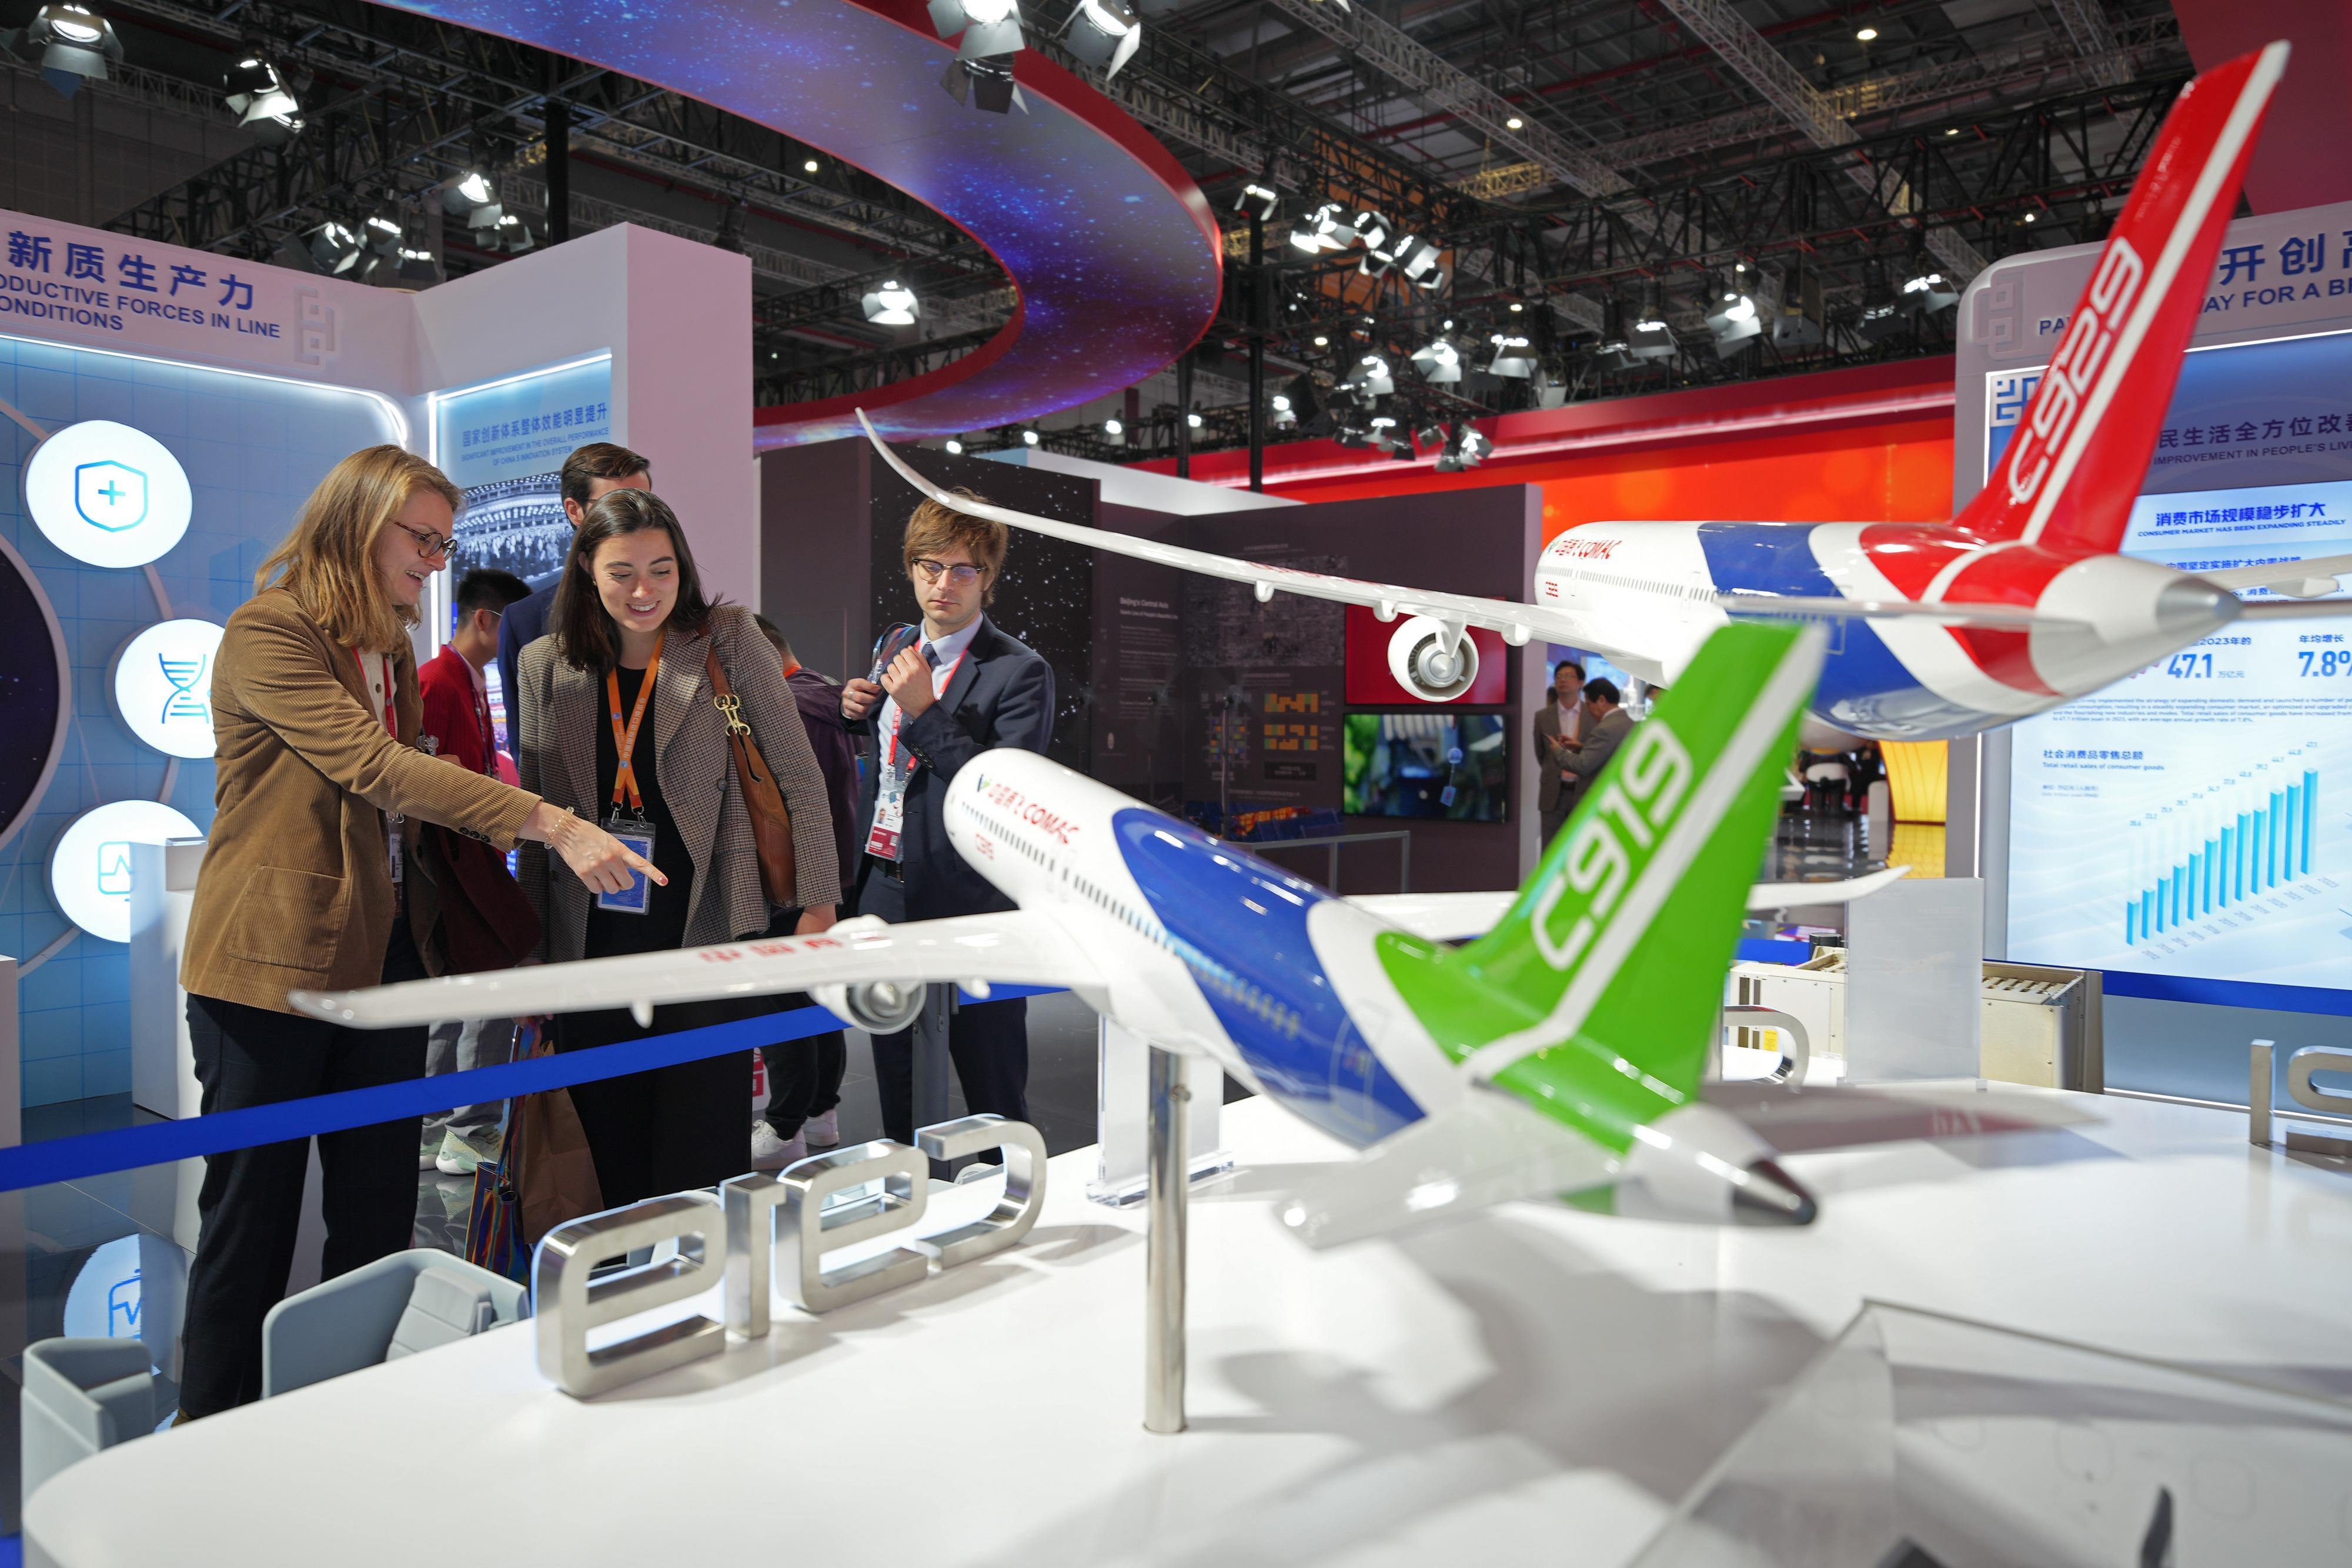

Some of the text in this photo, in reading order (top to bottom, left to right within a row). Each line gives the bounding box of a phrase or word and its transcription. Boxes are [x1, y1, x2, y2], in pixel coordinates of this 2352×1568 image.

[8, 230, 253, 310] 新质生产力
[2219, 230, 2352, 286] 开创
[0, 296, 123, 330] ONDITIONS
[117, 296, 205, 325] FORCES
[211, 313, 230, 329] IN
[238, 317, 280, 338] LINE
[2039, 316, 2071, 335] PA
[2243, 286, 2296, 307] FOR
[2302, 282, 2320, 300] A
[2008, 236, 2143, 504] C929
[462, 402, 607, 447] 国家创新体系整体效能明显提升
[490, 443, 525, 456] IMPROVEMENT
[532, 439, 542, 447] THE
[542, 436, 567, 447] OVERALL
[567, 427, 609, 442] PERFORMANCE
[2159, 413, 2352, 449] 民生活全方位改
[493, 458, 500, 466] OF
[521, 449, 551, 462] INNOVATION
[551, 445, 573, 456] SYSTEM
[2153, 450, 2242, 466] IMPROVEMENT
[2246, 449, 2259, 458] IN
[2263, 443, 2326, 456] PEOPLE'S
[2137, 529, 2180, 537] CONSUMER
[2257, 521, 2304, 531] EXPANDING
[2306, 519, 2346, 527] STEADILY
[2156, 502, 2326, 527] 消费市场规模稳步扩大
[2299, 634, 2344, 643] 年均增长
[2167, 653, 2212, 678] 47.1
[2043, 750, 2143, 760] 社会消费品零售总额
[1532, 718, 1694, 971] C919
